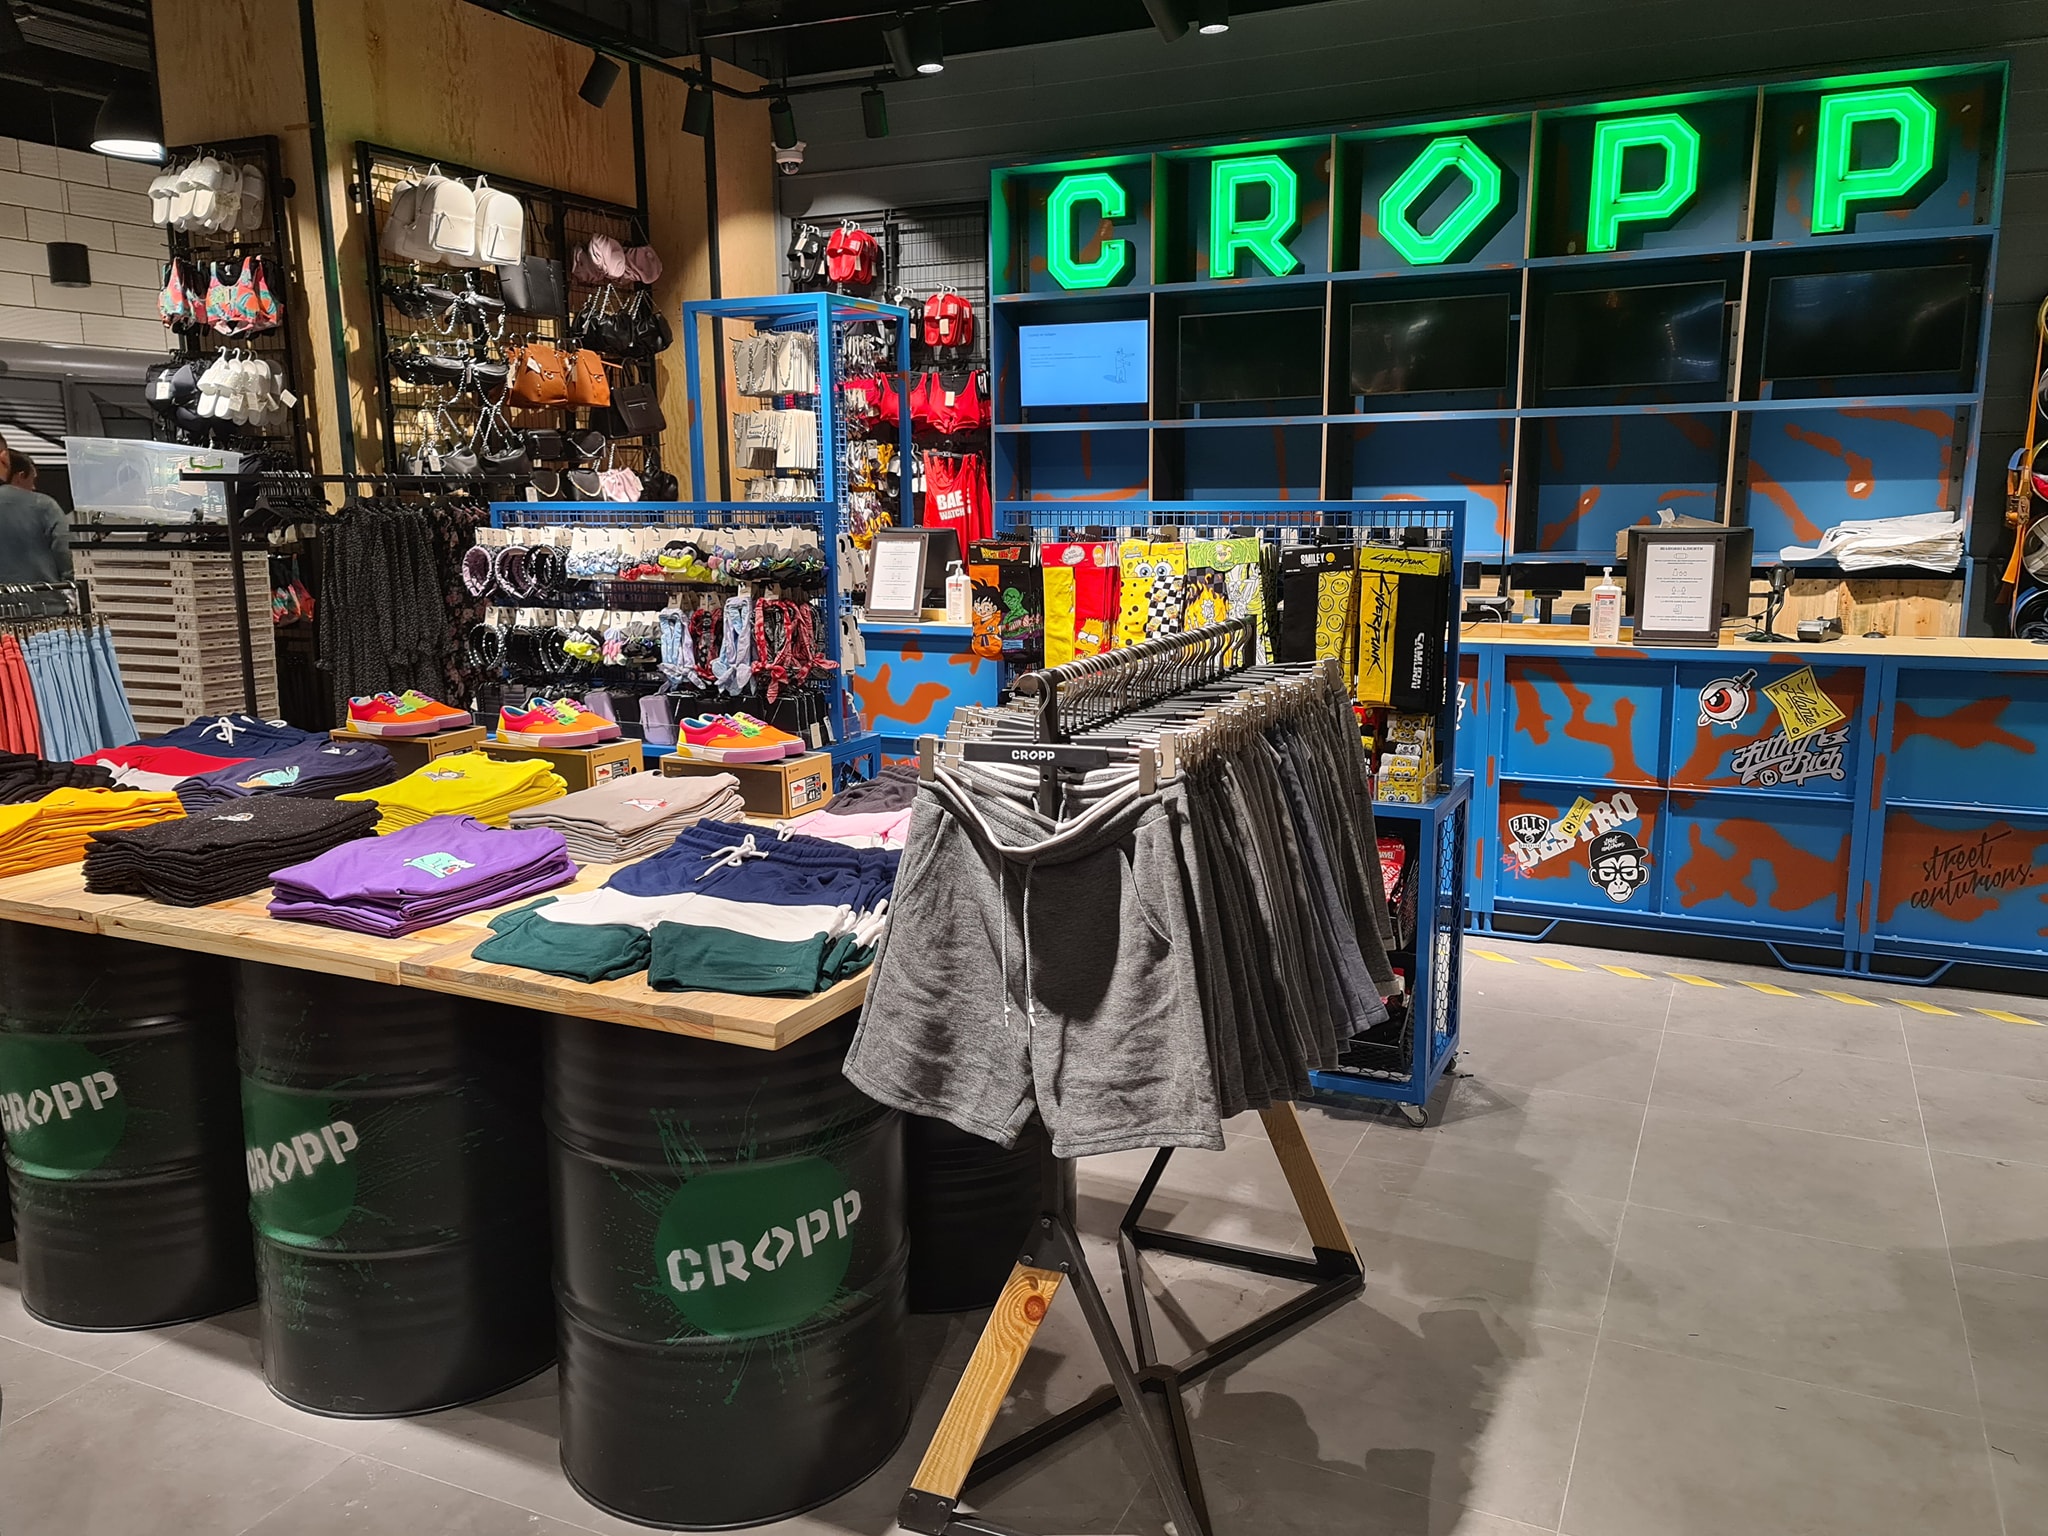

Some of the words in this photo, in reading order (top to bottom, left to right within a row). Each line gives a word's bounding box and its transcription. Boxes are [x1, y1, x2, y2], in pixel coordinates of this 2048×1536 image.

[1045, 86, 1937, 289] CROPP
[936, 490, 964, 511] BAE
[939, 507, 965, 521] WATCH
[1411, 632, 1425, 690] SAMURAI
[1011, 749, 1056, 761] CROPP
[1779, 746, 1847, 786] Rich
[1513, 816, 1545, 832] BATS
[1923, 830, 2011, 882] street
[0, 1071, 118, 1131] CROPP
[667, 1189, 862, 1293] CROPP
